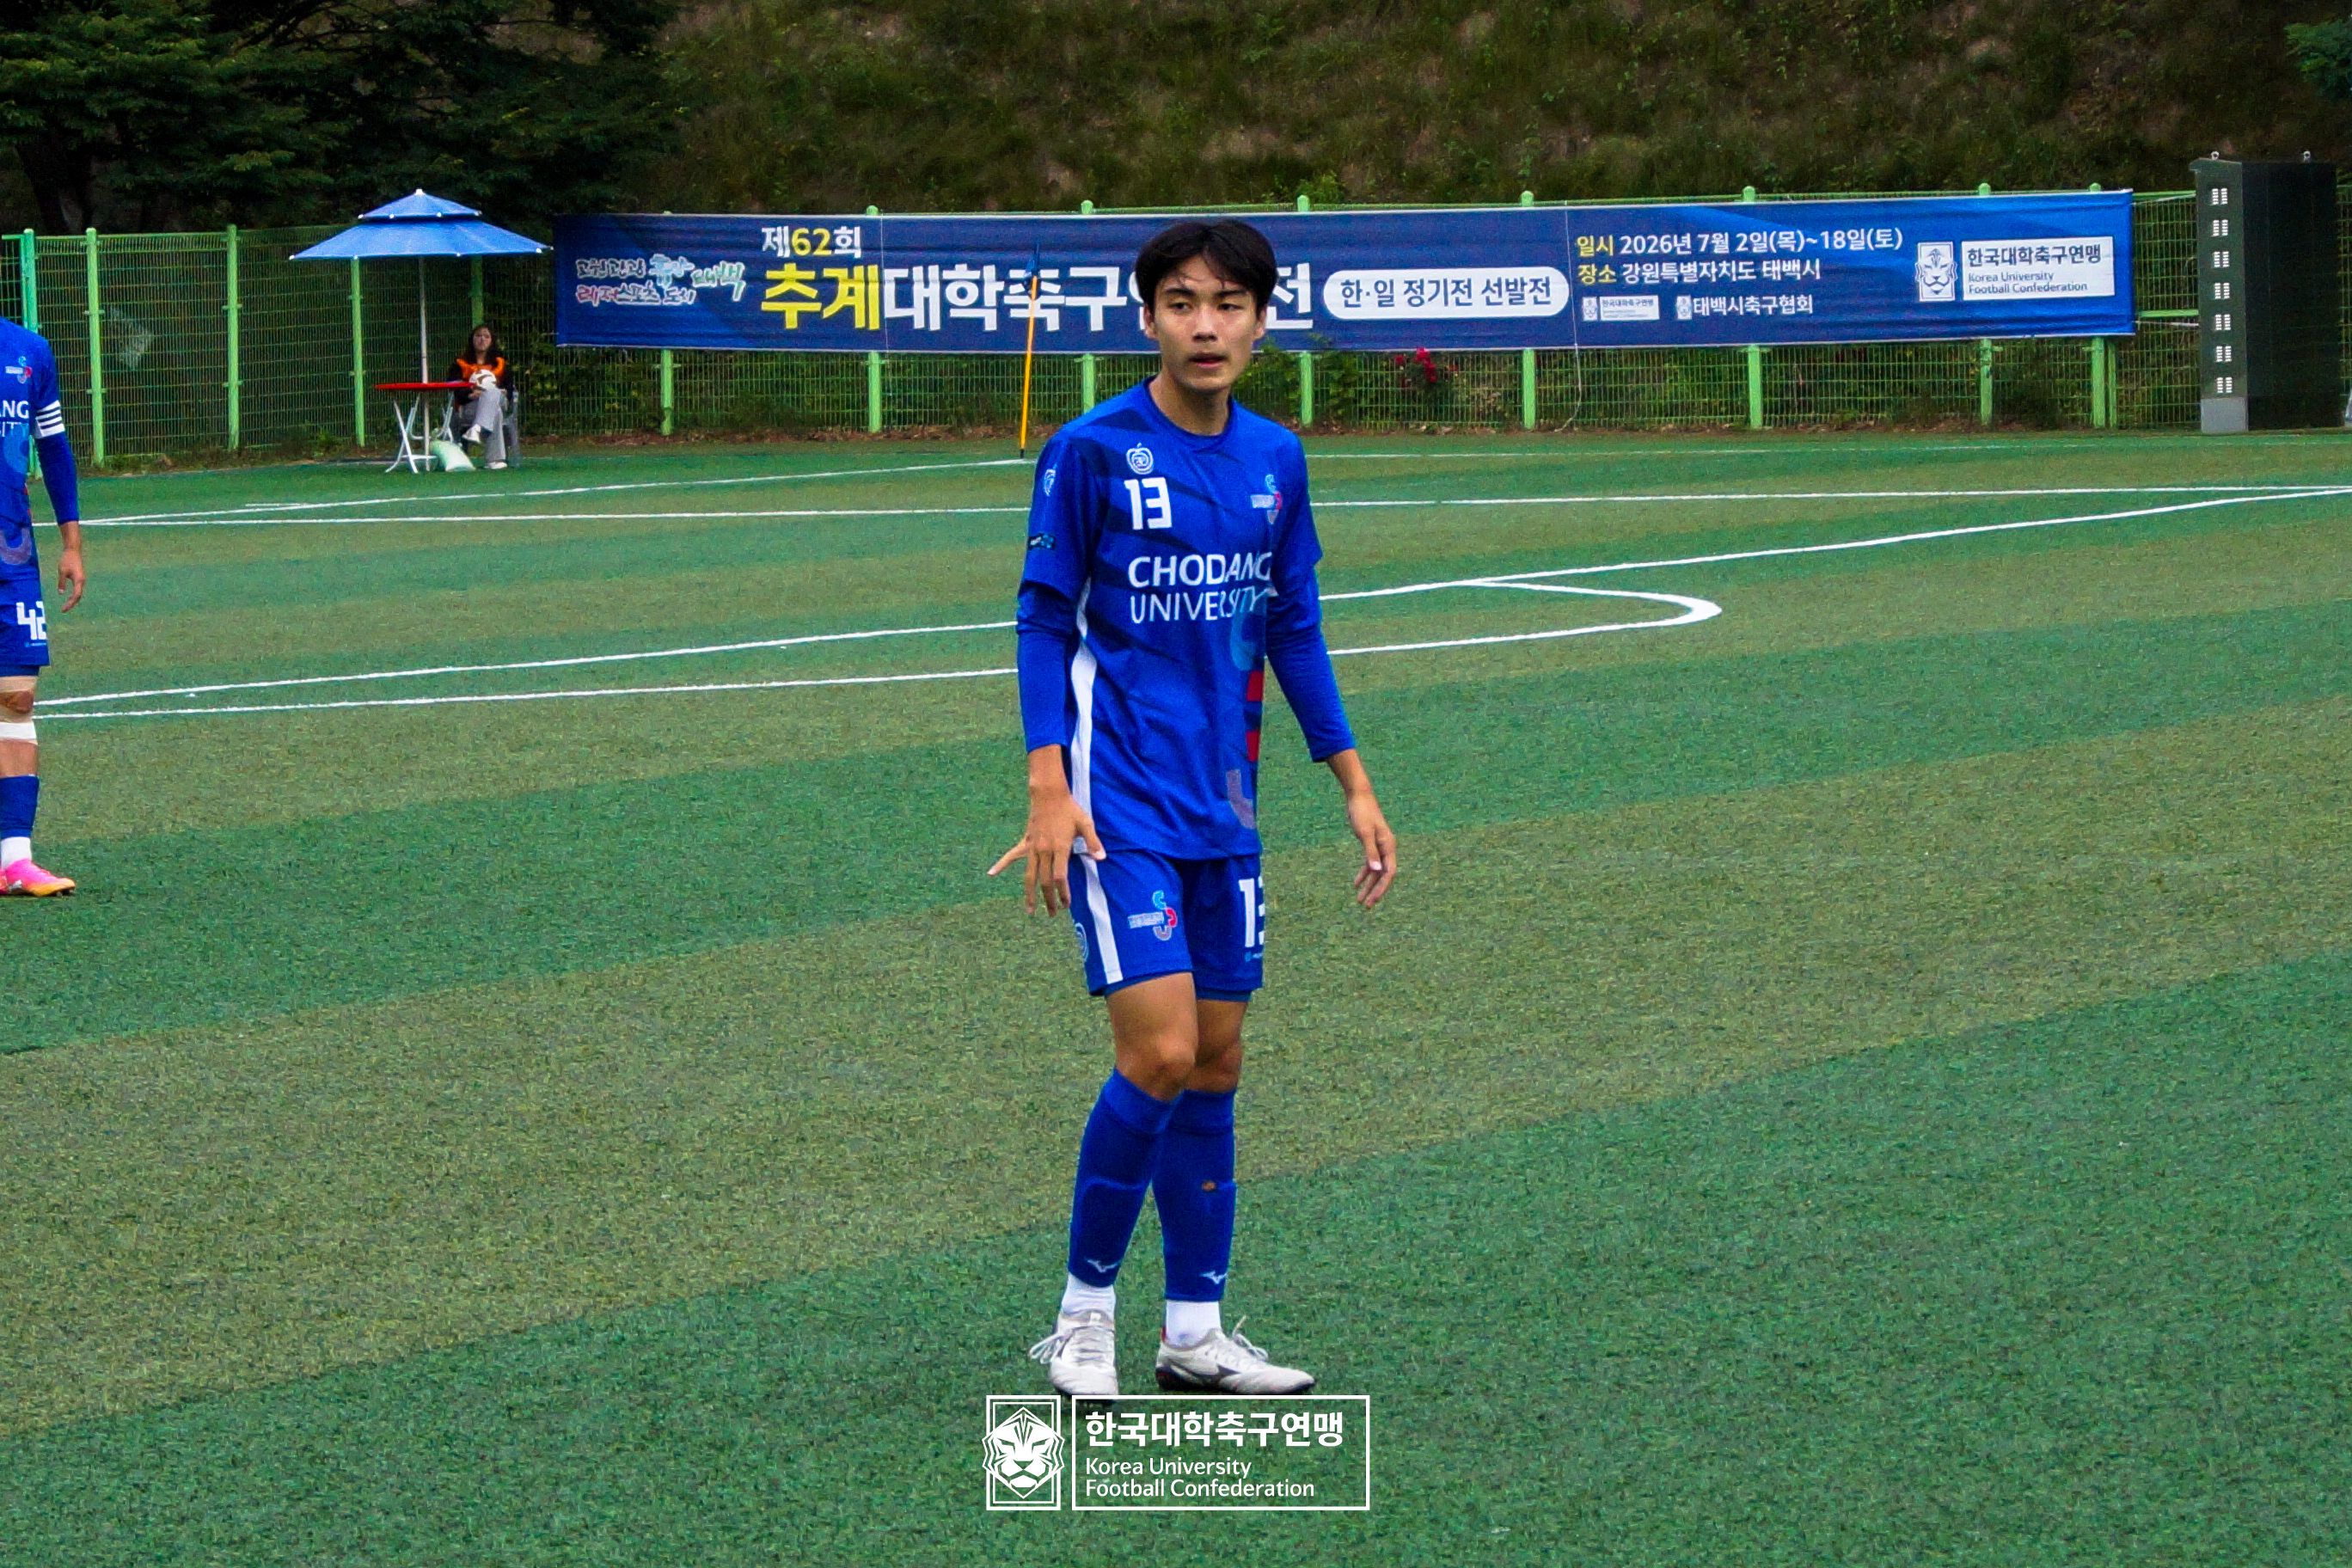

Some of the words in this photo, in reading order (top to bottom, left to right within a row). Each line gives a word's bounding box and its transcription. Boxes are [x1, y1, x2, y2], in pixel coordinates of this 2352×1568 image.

[762, 225, 862, 259] 제62회
[1576, 236, 1614, 257] 일시
[1620, 234, 1692, 254] 2026년
[1698, 233, 1730, 254] 7월
[1736, 228, 1903, 253] 2일(목)~18일(토)
[1968, 243, 2101, 267] 한국대학축구연맹
[691, 260, 746, 301] 태백
[1577, 263, 1617, 284] 장소
[1622, 260, 1756, 285] 강원특별자치도
[1762, 258, 1822, 281] 태백시
[1969, 272, 1999, 282] Korea
[2001, 271, 2054, 283] University
[1340, 278, 1394, 308] 한·일
[1403, 277, 1473, 308] 정기전
[1481, 276, 1551, 307] 선발전
[1969, 283, 2010, 294] Football
[2013, 282, 2087, 293] Confederation
[1694, 294, 1814, 316] 태백시축구협회
[0, 400, 29, 419] NG
[1124, 476, 1173, 530] 13
[1128, 551, 1273, 588] CHODANG
